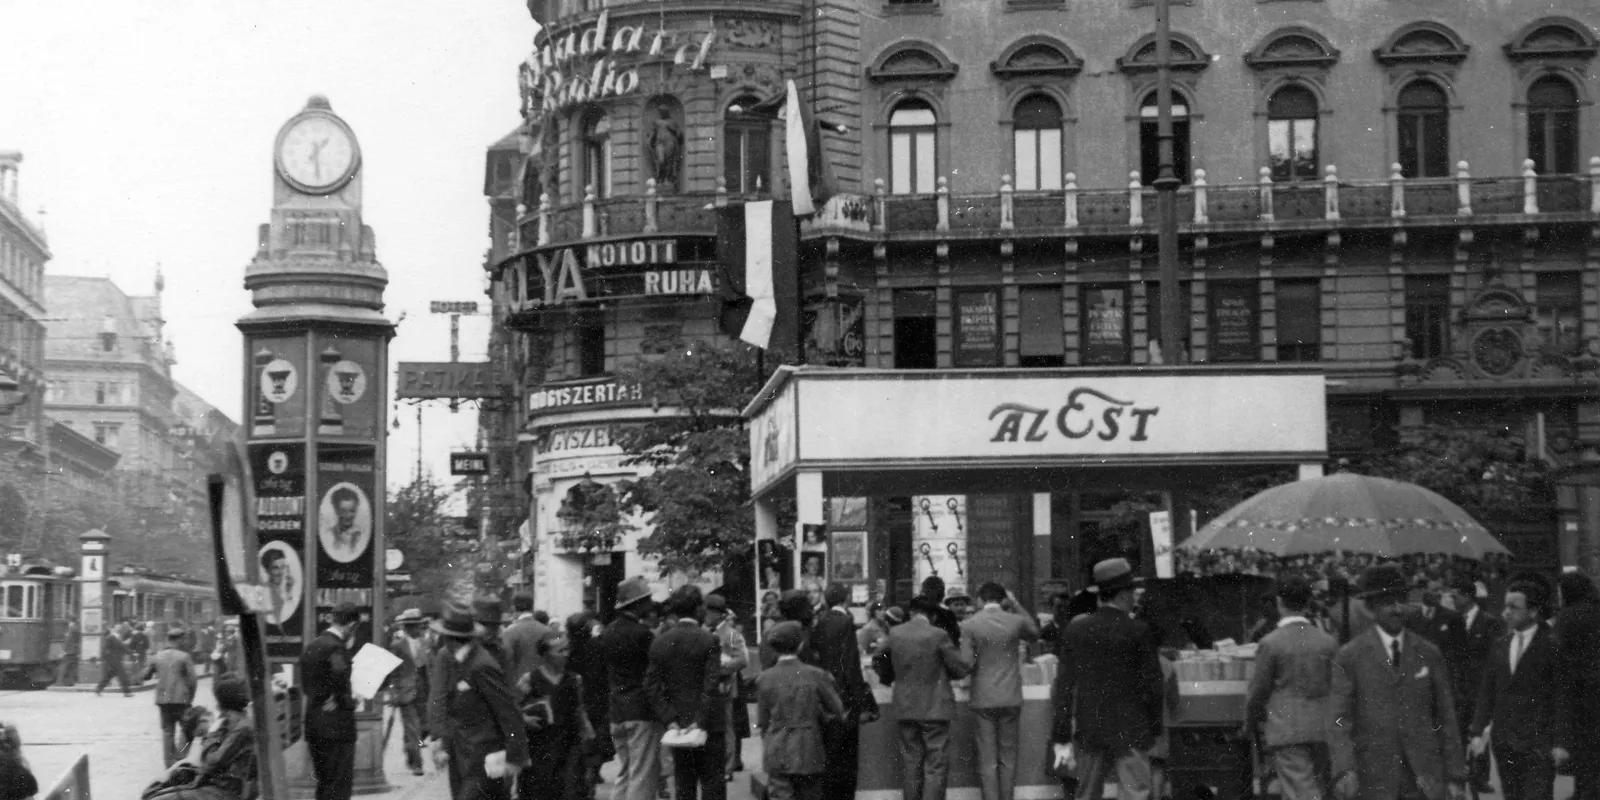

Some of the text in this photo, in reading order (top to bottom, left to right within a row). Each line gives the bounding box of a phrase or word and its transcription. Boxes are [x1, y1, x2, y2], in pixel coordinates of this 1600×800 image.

[542, 58, 638, 111] Radio
[645, 269, 713, 295] RUHA
[988, 386, 1159, 442] AZ EST
